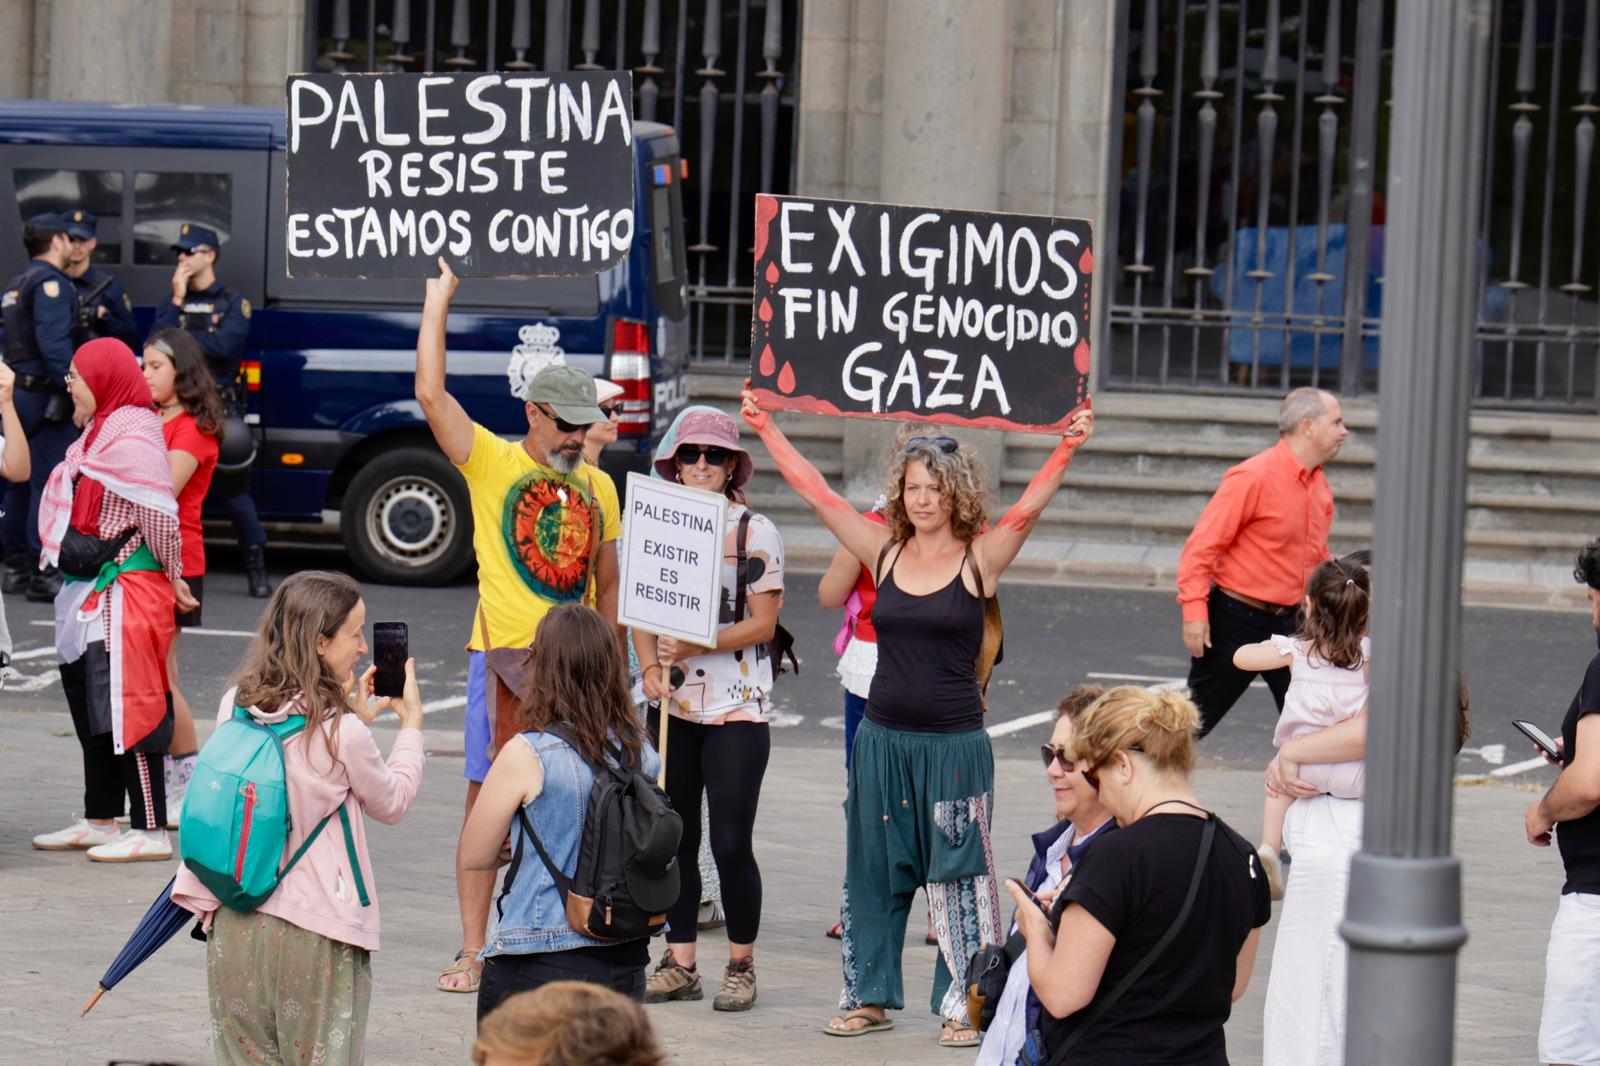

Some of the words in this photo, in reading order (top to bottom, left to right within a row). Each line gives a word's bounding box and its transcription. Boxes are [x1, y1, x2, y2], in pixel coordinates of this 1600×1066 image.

[290, 75, 632, 154] PALESTINA
[358, 150, 568, 198] RESISTE
[287, 206, 472, 259] ESTAMOS
[488, 203, 634, 262] CONTIGO
[780, 201, 1080, 300] EXIGIMOS
[778, 285, 859, 341] FIN
[882, 291, 1078, 352] GENOCIDIO
[841, 341, 1012, 415] GAZA
[634, 500, 714, 535] PALESTINA
[643, 539, 699, 567] EXISTIR
[659, 567, 679, 585] ES
[635, 582, 701, 612] RESISTIR
